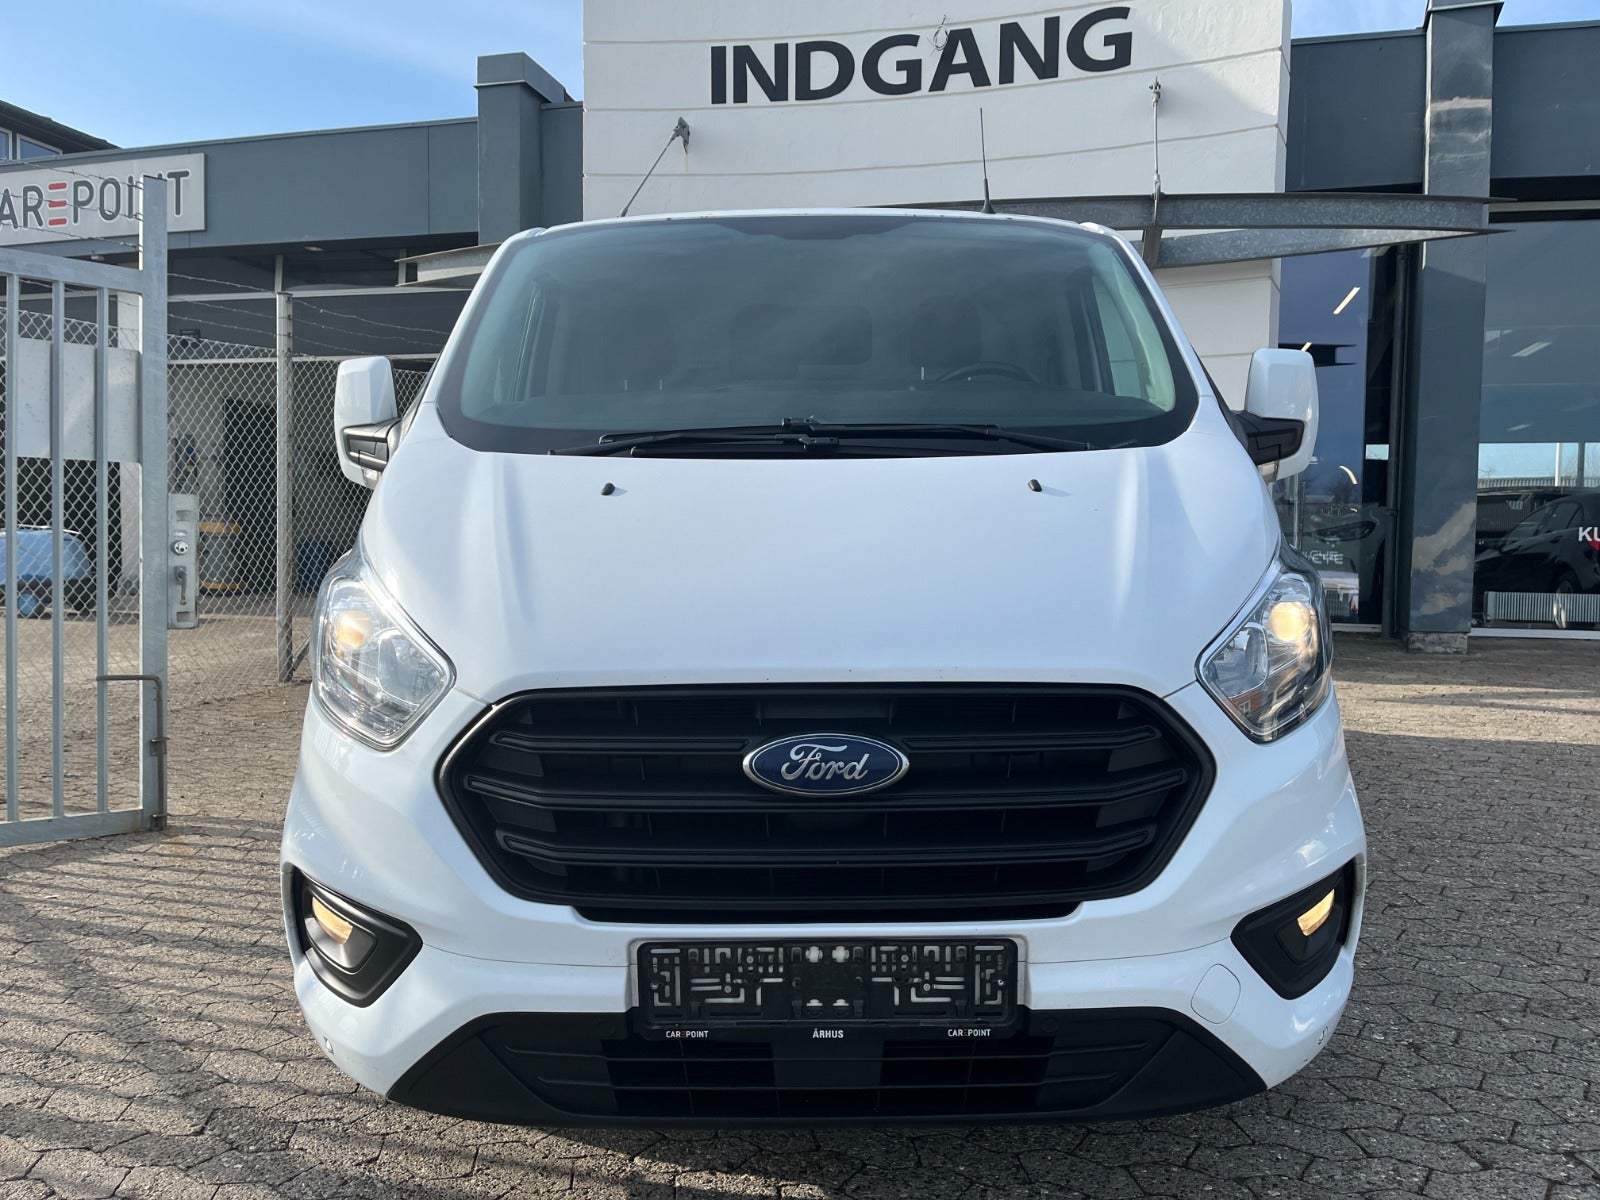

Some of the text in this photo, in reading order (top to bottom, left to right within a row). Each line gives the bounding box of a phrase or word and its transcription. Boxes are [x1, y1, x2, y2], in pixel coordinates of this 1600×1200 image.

[710, 6, 1133, 105] INDGANG
[780, 743, 870, 781] Ford
[812, 1027, 844, 1039] ÅRHUS
